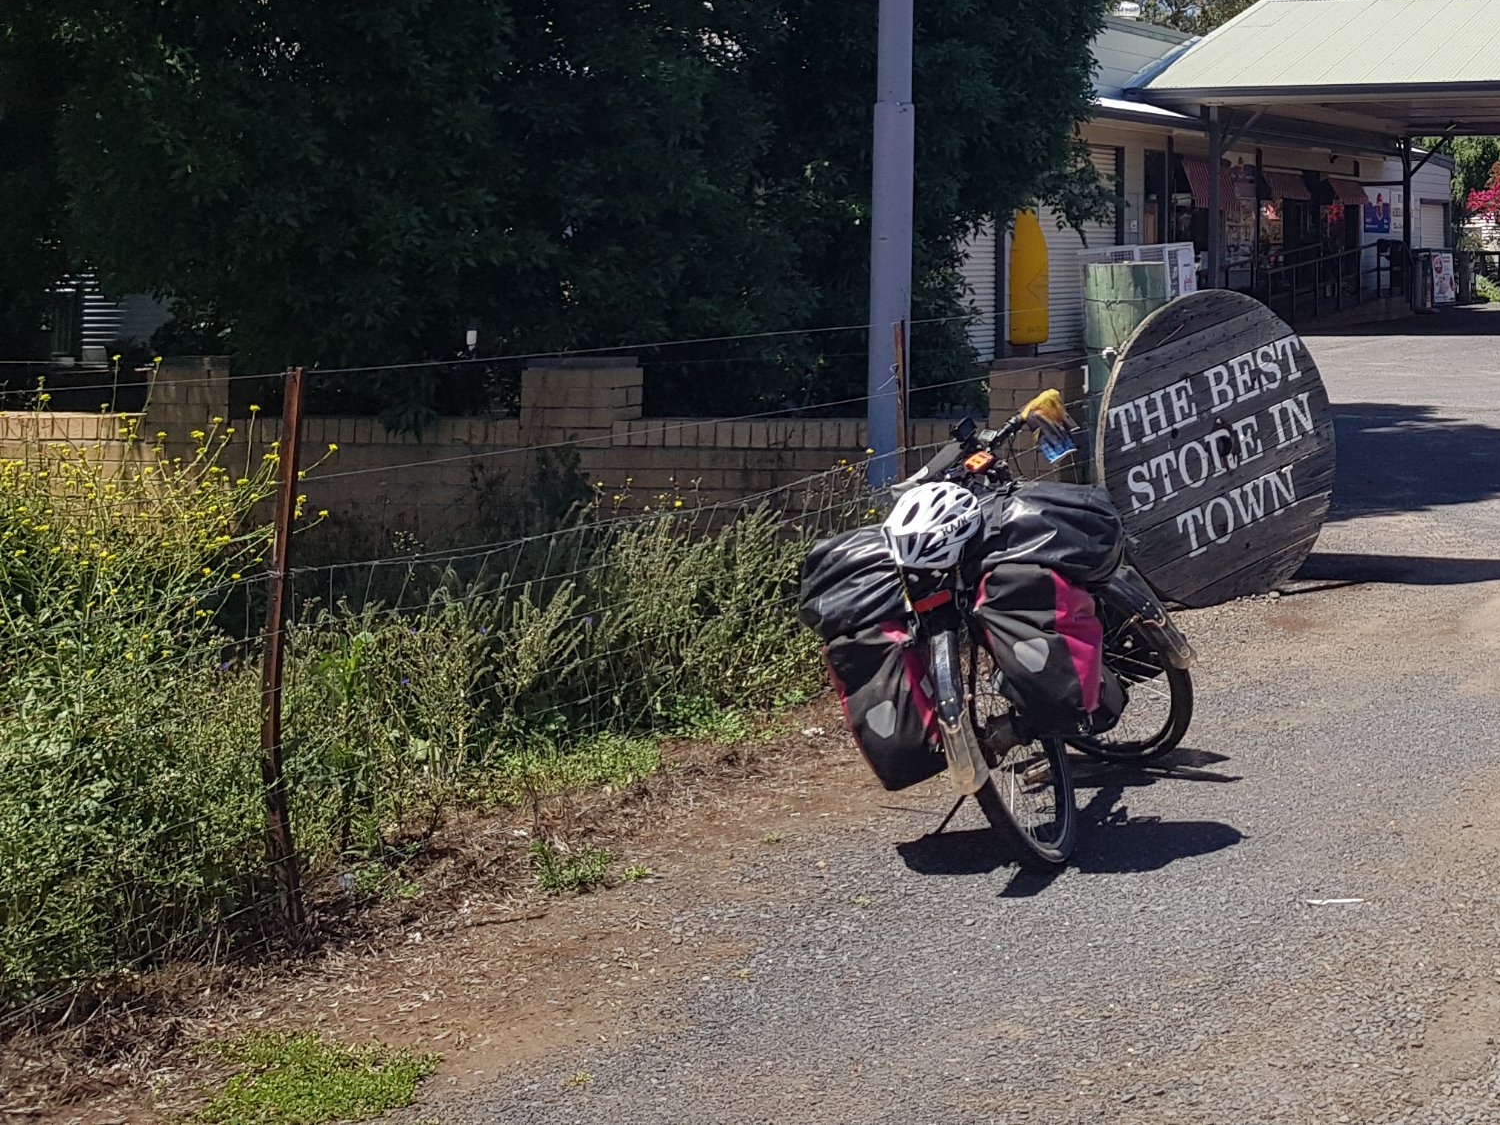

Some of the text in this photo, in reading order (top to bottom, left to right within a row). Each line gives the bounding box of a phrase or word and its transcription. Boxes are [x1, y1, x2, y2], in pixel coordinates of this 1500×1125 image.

[1108, 334, 1302, 452] THE BEST
[1127, 392, 1317, 514] STORE IN
[1176, 464, 1299, 559] TOWN
